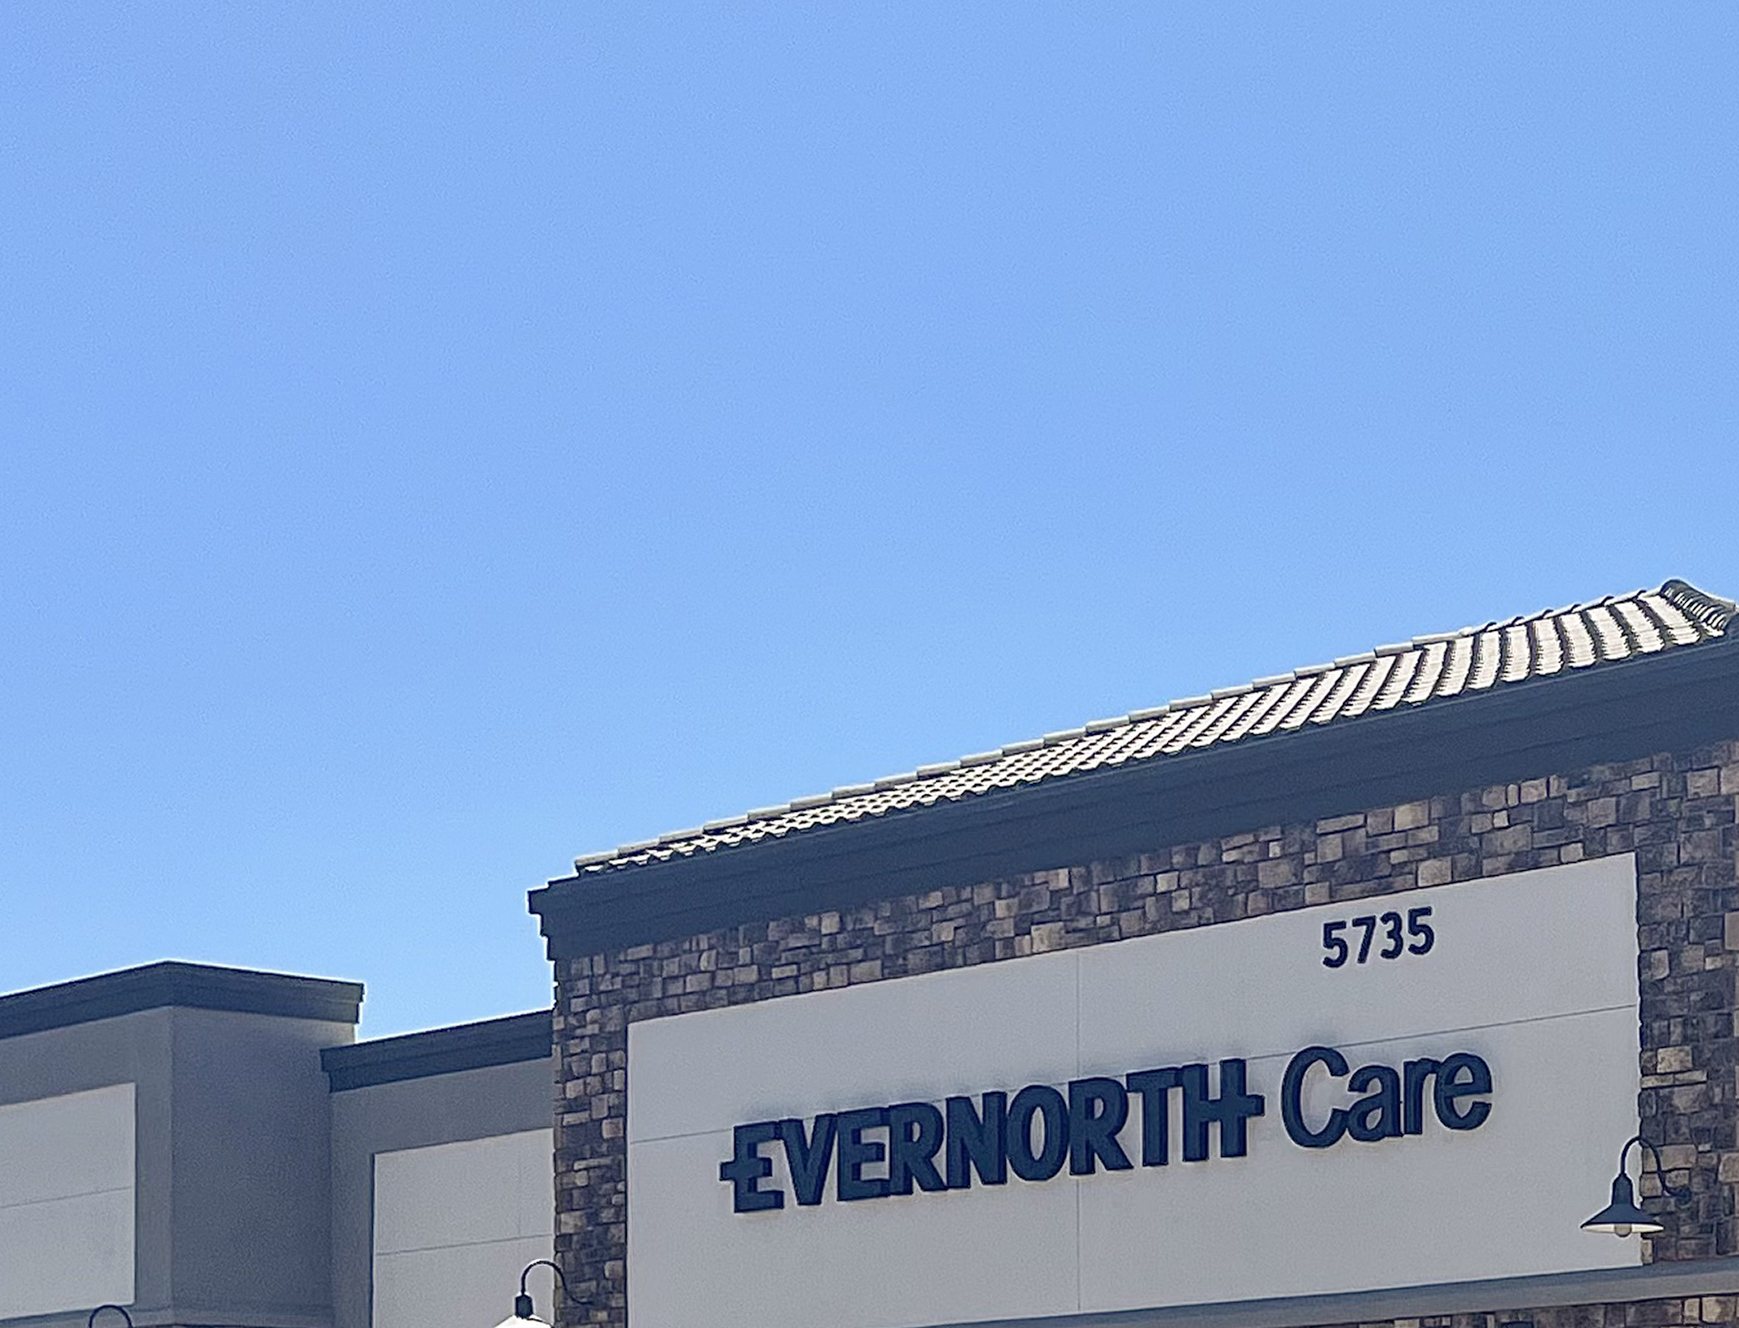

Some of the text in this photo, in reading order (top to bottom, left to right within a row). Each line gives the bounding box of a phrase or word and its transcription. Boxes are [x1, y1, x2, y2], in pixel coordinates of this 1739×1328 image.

[1322, 907, 1435, 969] 5735
[720, 1046, 1493, 1214] EVERNORTH Care
